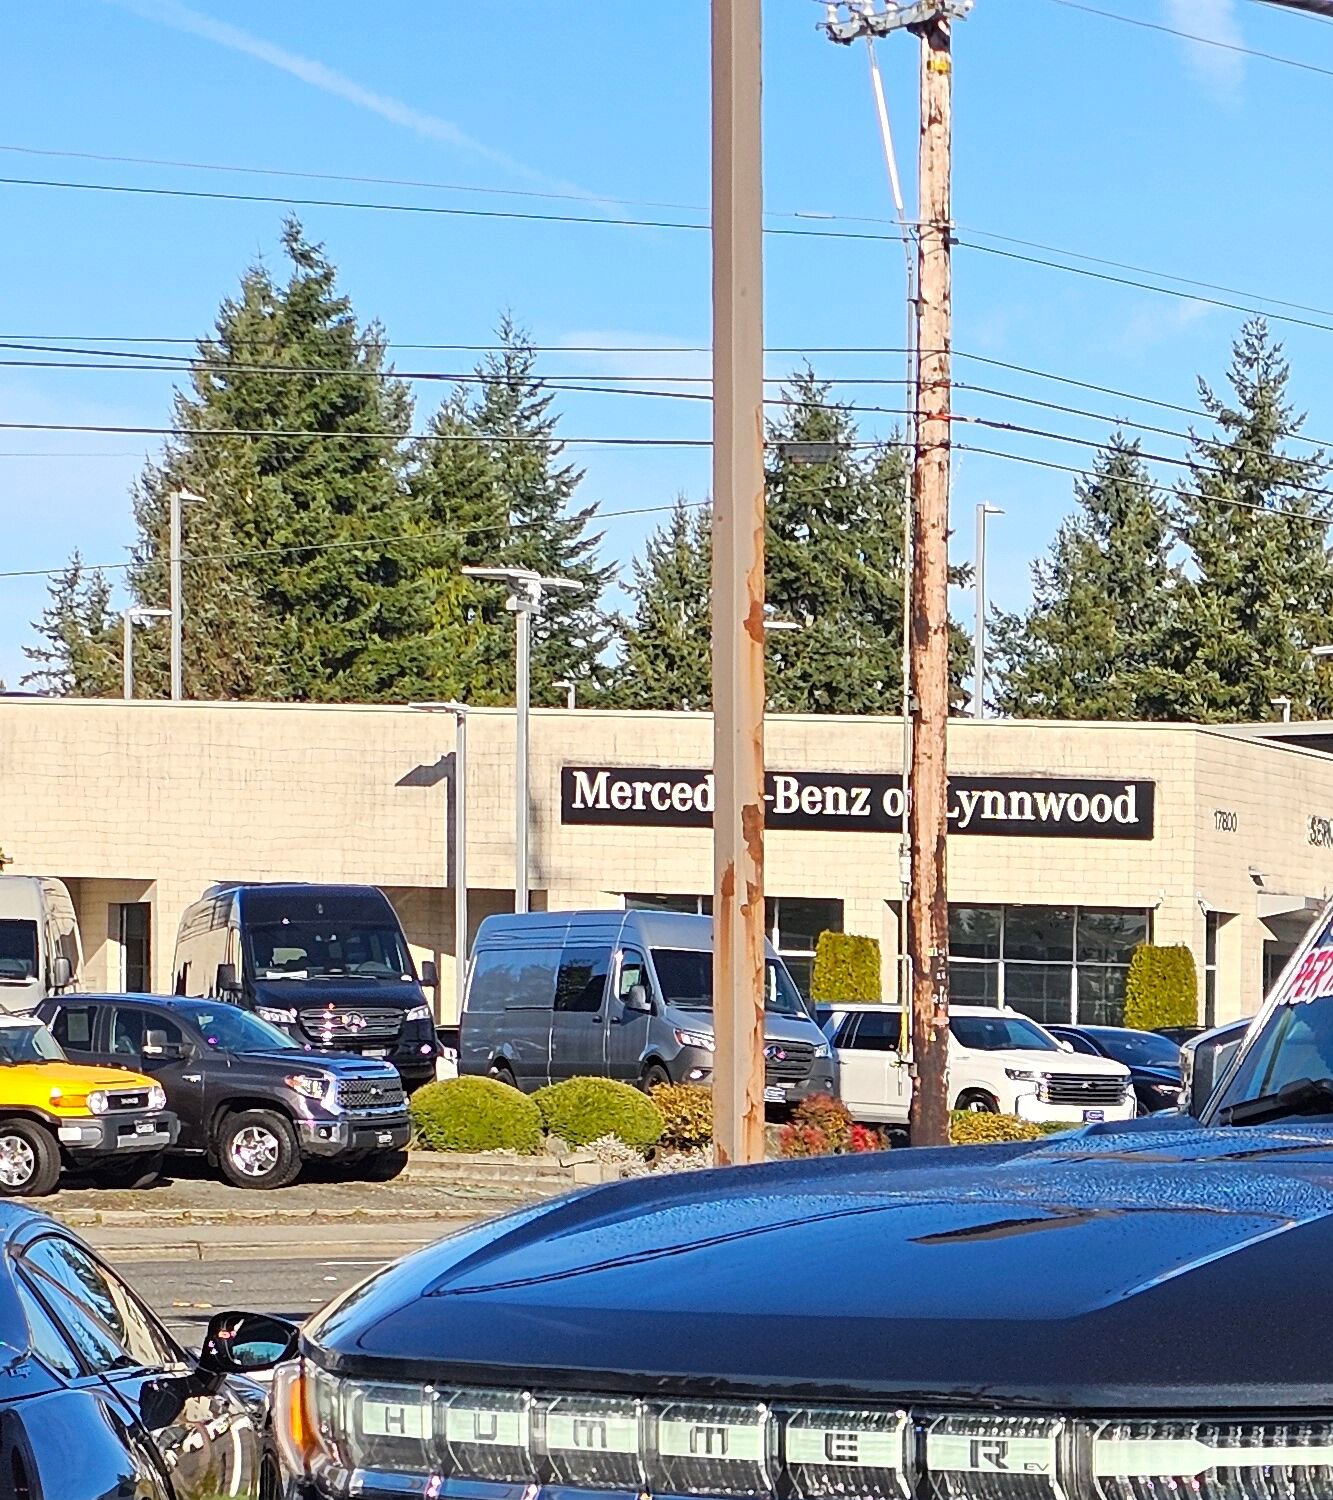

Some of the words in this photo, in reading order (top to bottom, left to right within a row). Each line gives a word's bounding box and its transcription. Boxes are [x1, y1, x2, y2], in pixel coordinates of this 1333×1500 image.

[571, 770, 873, 817] Merced-Benz
[1213, 808, 1238, 833] 17800
[1023, 1462, 1050, 1472] EV
